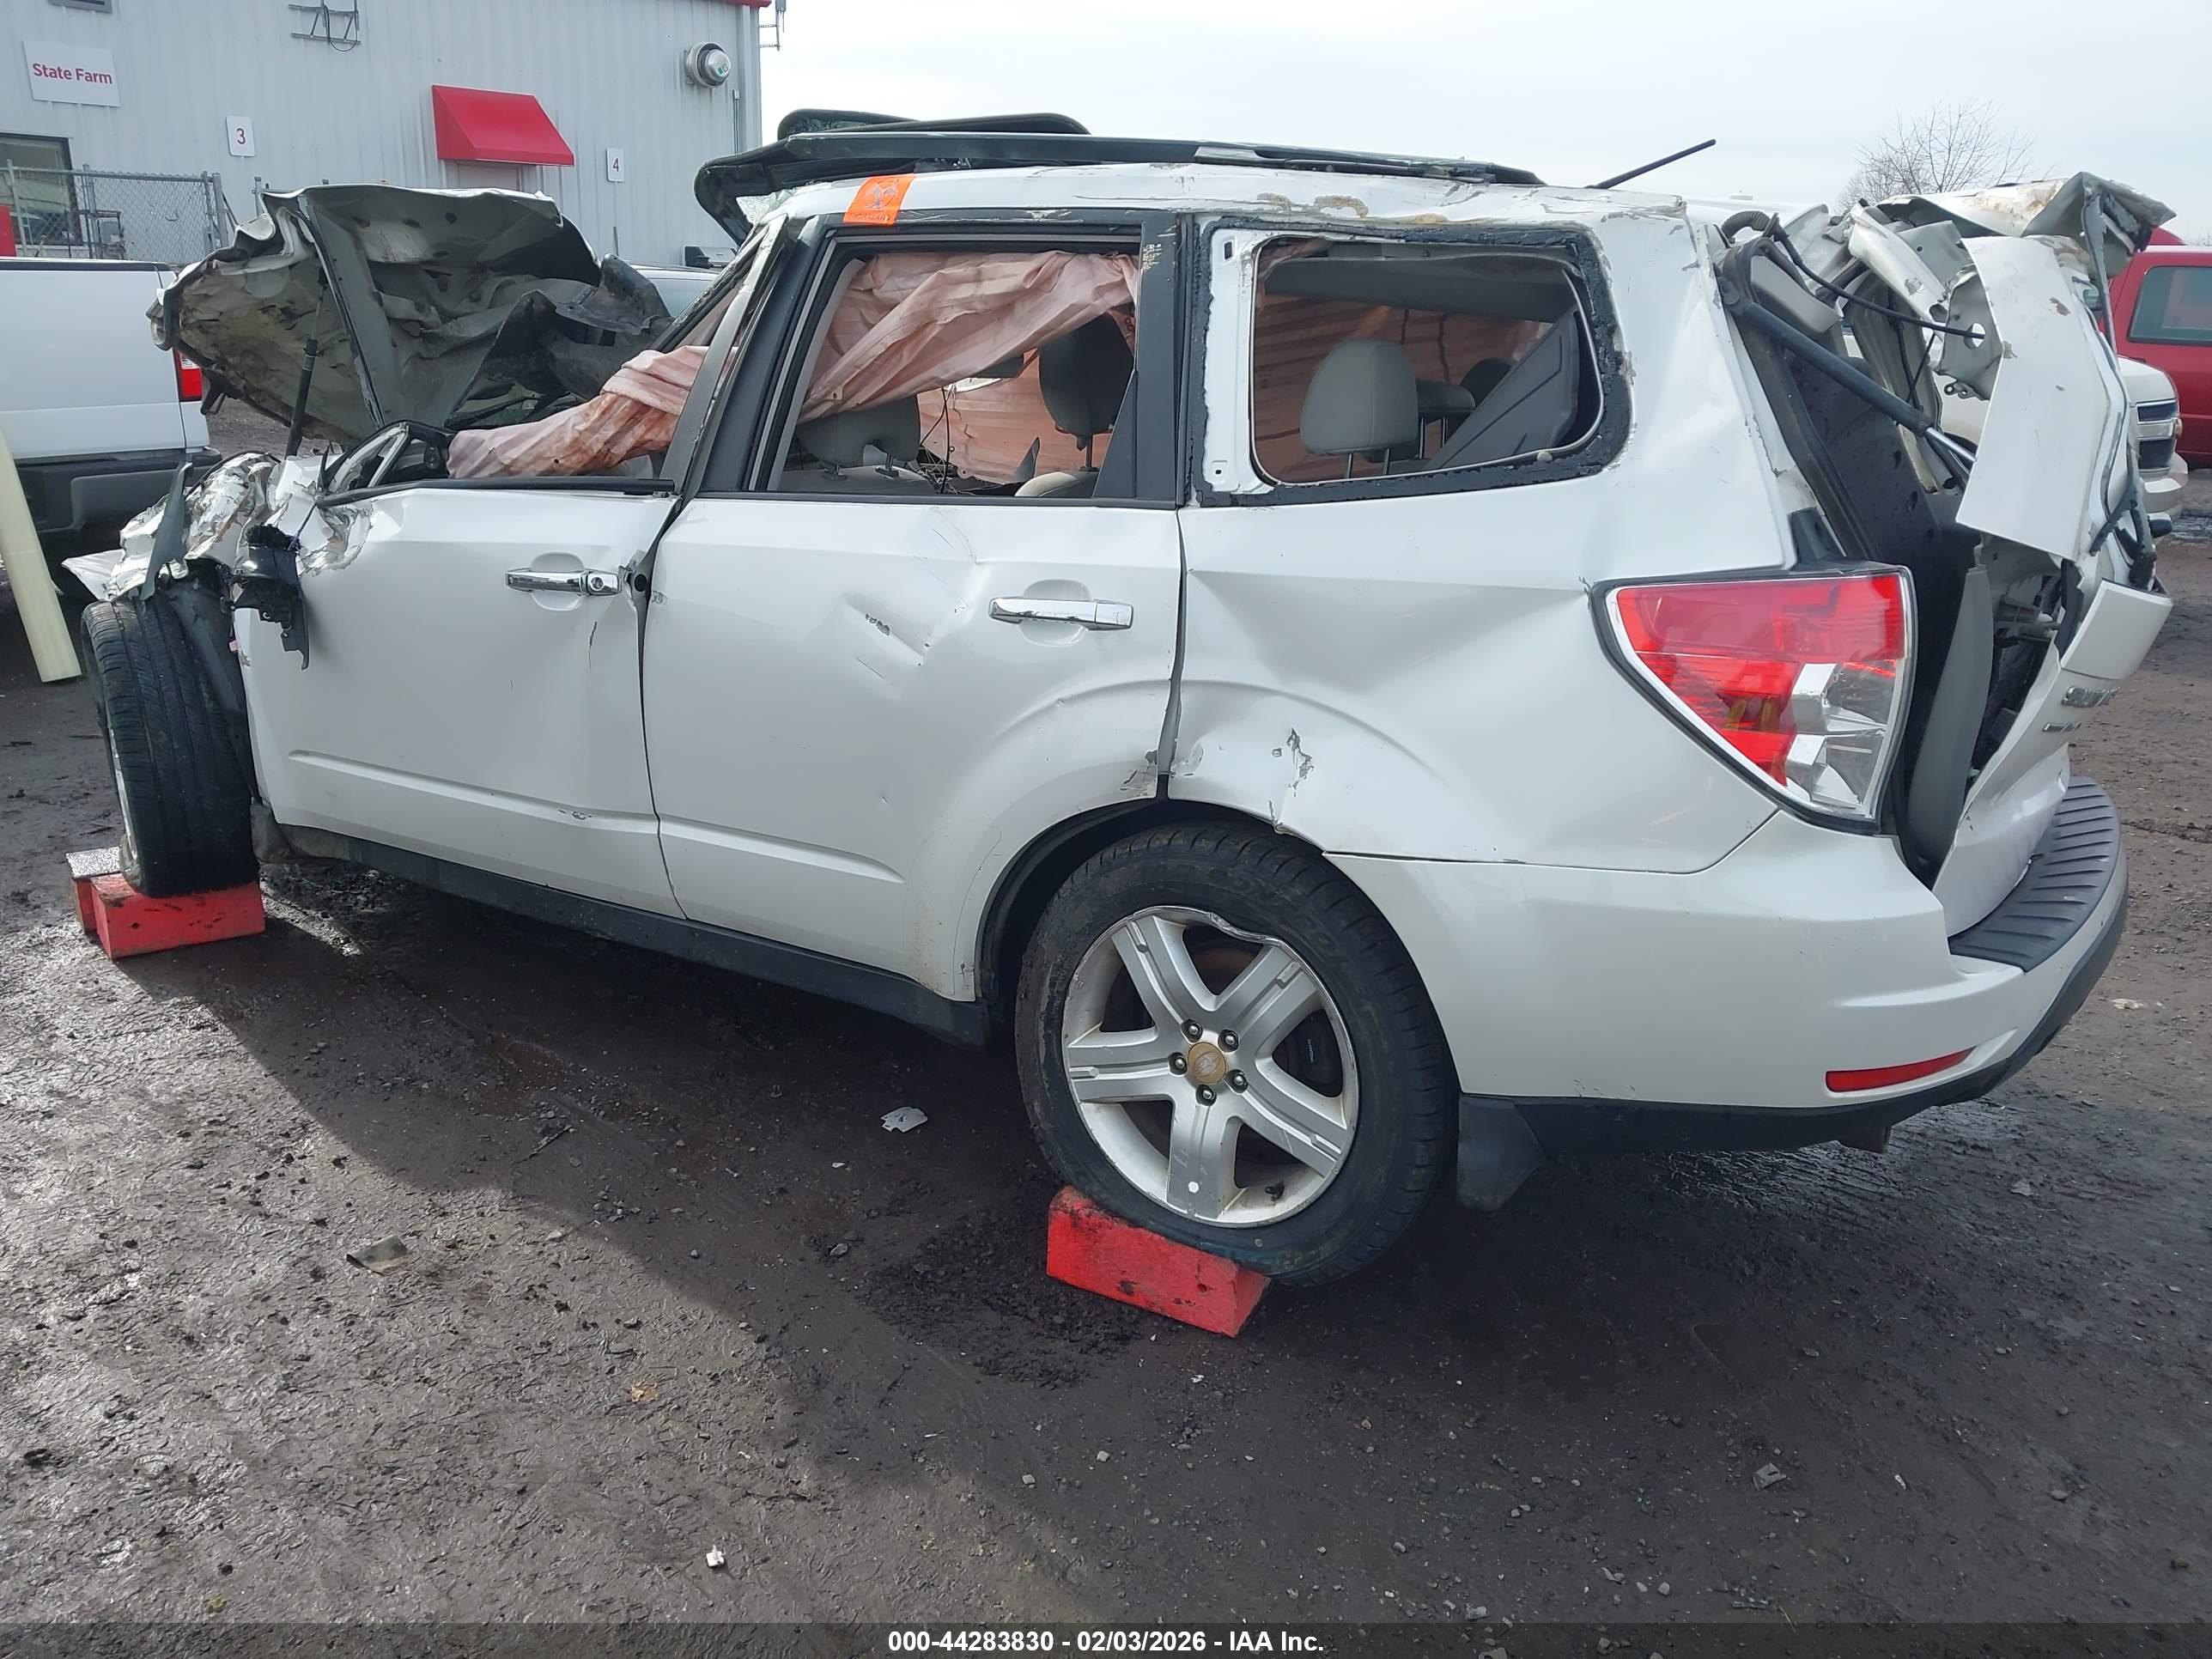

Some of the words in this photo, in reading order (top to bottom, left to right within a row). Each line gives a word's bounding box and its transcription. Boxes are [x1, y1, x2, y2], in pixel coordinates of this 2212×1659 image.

[32, 63, 73, 80] State
[75, 68, 112, 84] Farm
[235, 127, 246, 145] 3
[612, 157, 620, 173] 4
